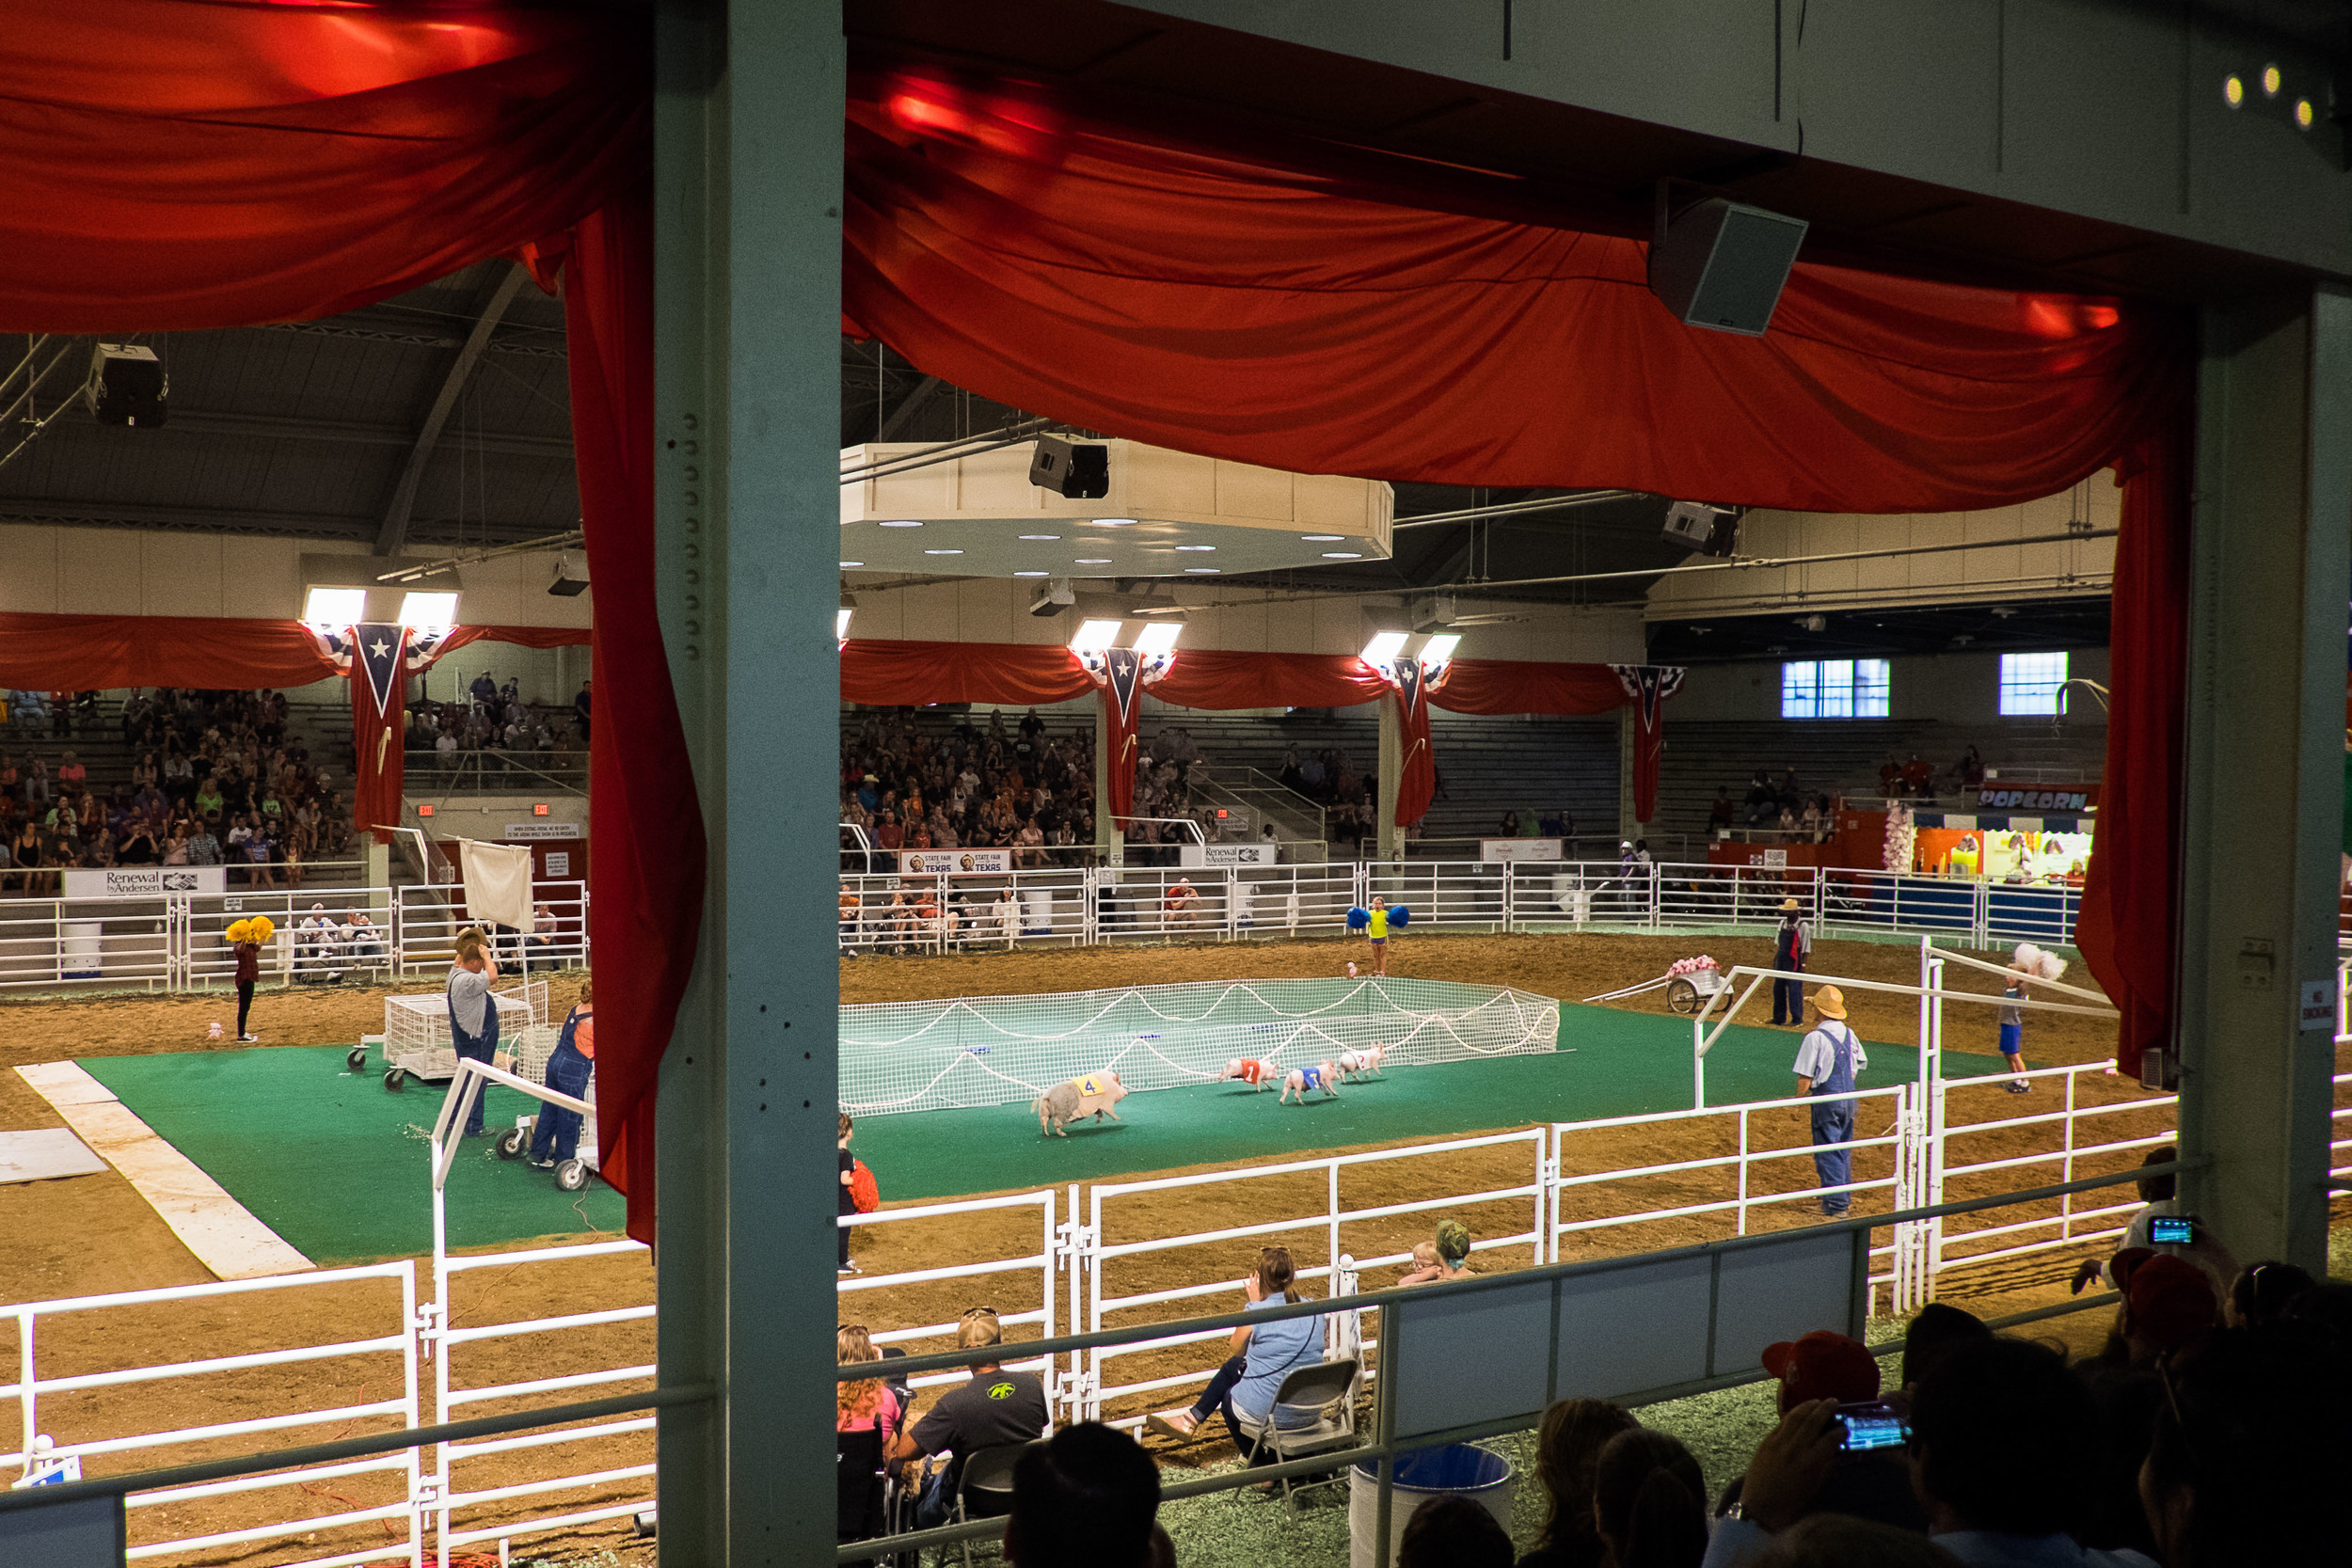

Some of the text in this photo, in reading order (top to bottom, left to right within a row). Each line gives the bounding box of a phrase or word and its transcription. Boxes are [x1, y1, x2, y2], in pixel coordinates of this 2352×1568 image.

[1978, 790, 2088, 810] POPCORN
[535, 804, 548, 815] EXIT
[1205, 847, 1237, 856] Renewal
[106, 871, 159, 884] Renewal
[114, 883, 160, 893] Andersen
[1245, 1065, 1254, 1082] 1
[1085, 1079, 1095, 1093] 4
